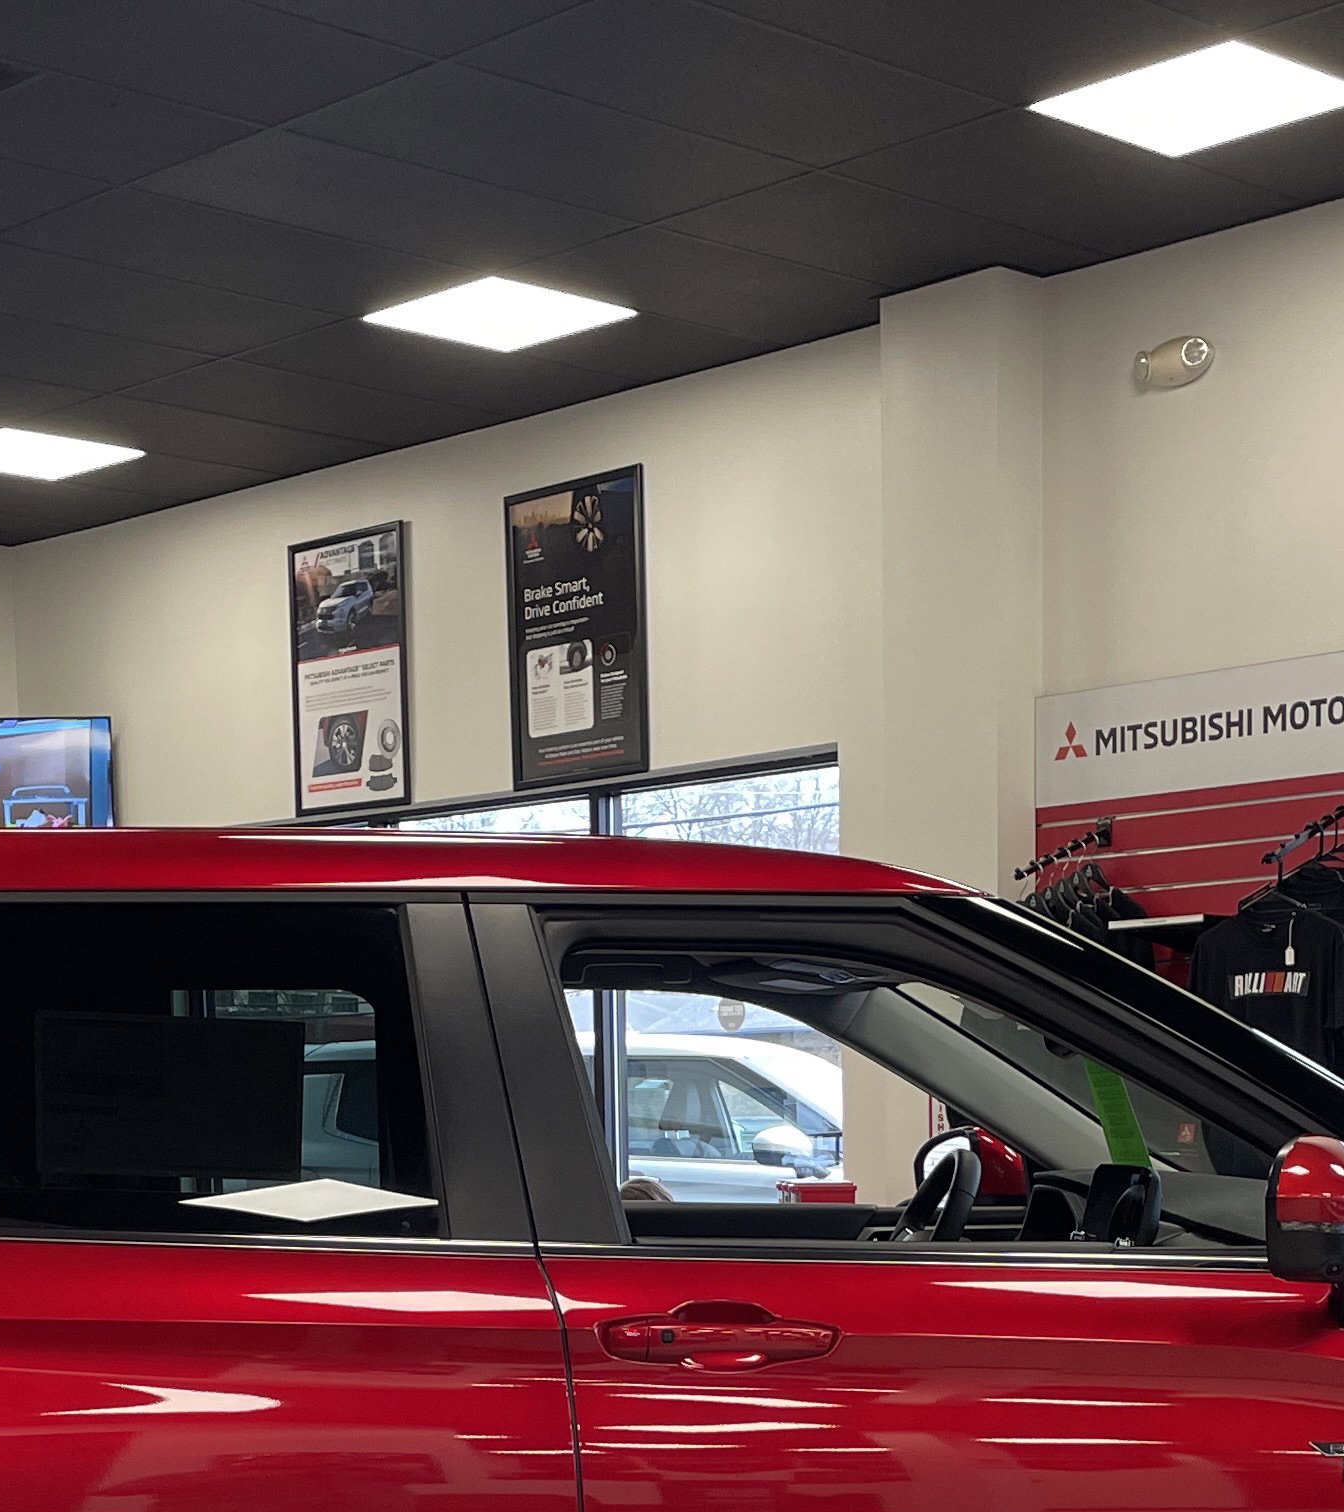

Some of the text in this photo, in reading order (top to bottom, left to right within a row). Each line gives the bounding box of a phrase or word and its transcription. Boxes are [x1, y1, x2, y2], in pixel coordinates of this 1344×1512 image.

[524, 577, 590, 602] Brake Smart,
[525, 592, 604, 621] Drive Confident
[1095, 709, 1253, 756] MITSUBISHI
